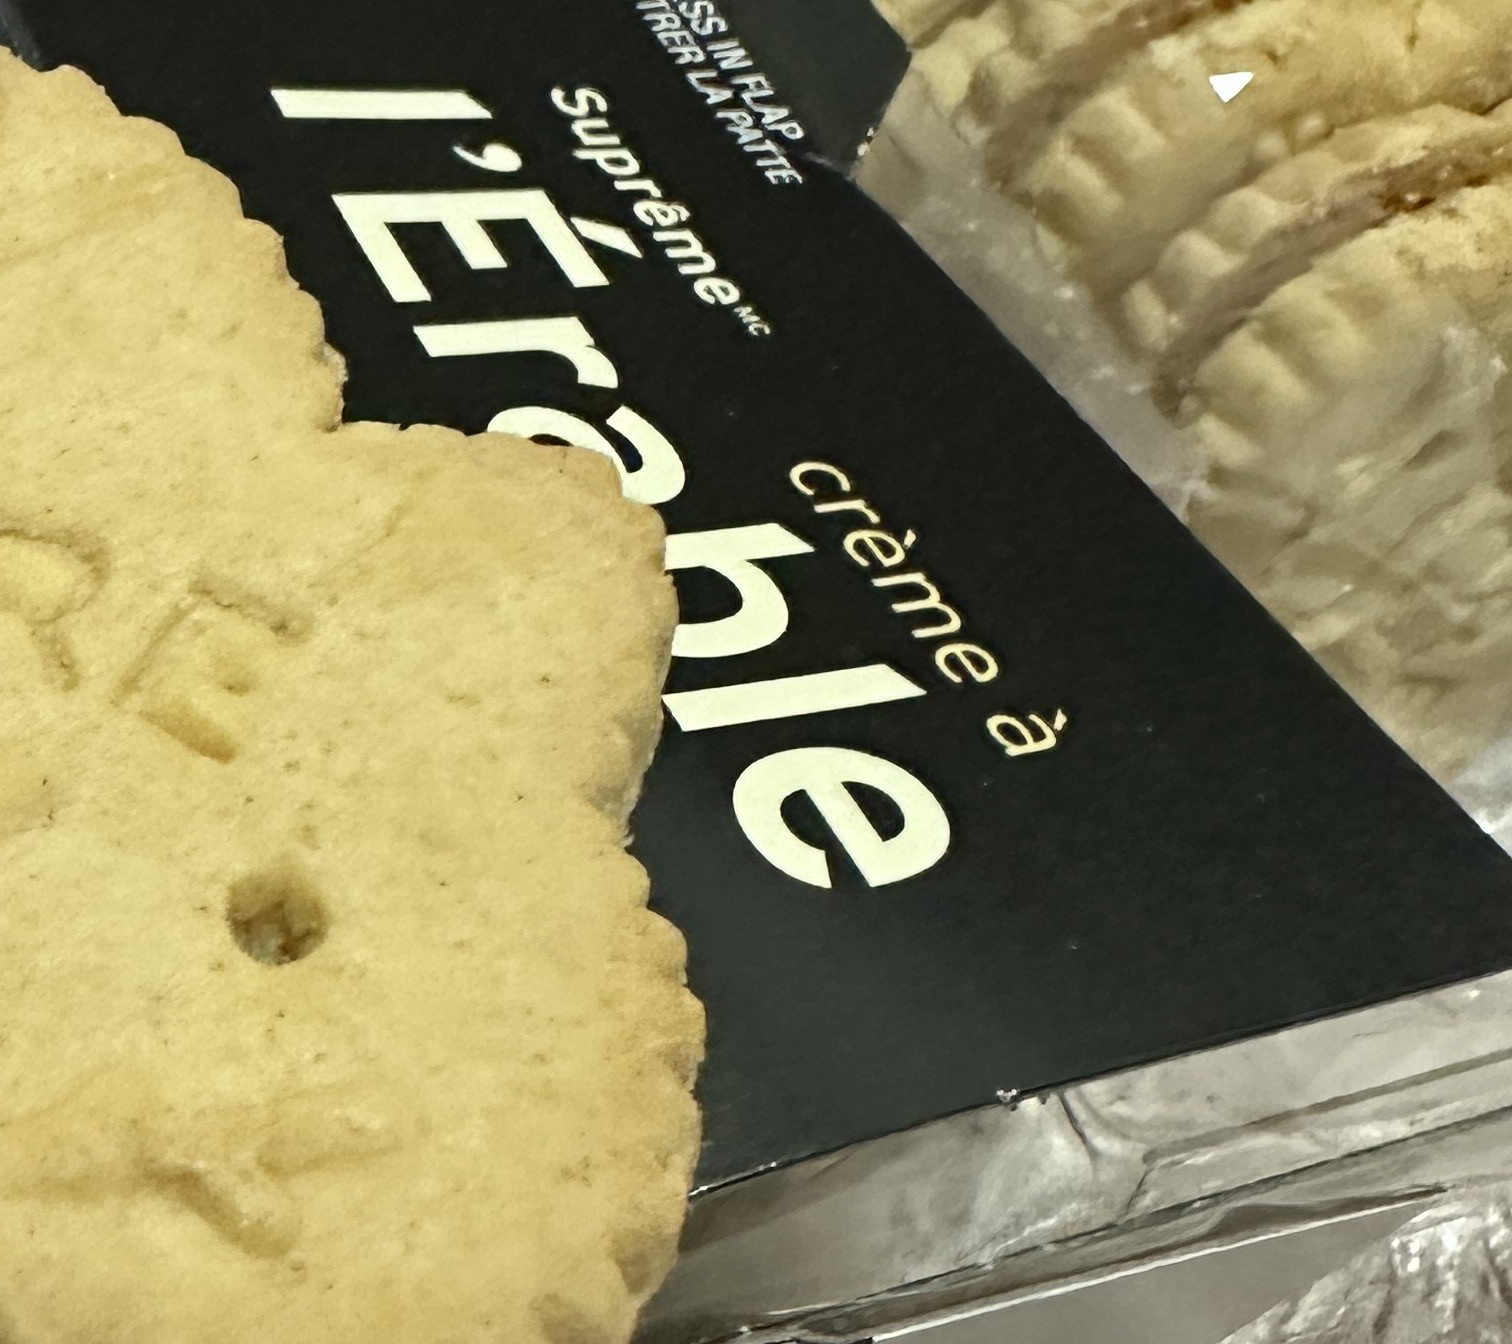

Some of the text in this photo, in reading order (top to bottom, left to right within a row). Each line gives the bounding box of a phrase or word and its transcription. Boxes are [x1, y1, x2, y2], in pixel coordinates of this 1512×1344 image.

[685, 68, 735, 105] LA
[715, 108, 804, 185] PATTE
[707, 38, 753, 69] IN
[730, 73, 805, 140] FLAP
[551, 86, 740, 306] Suprême
[789, 461, 1068, 757] crème à
